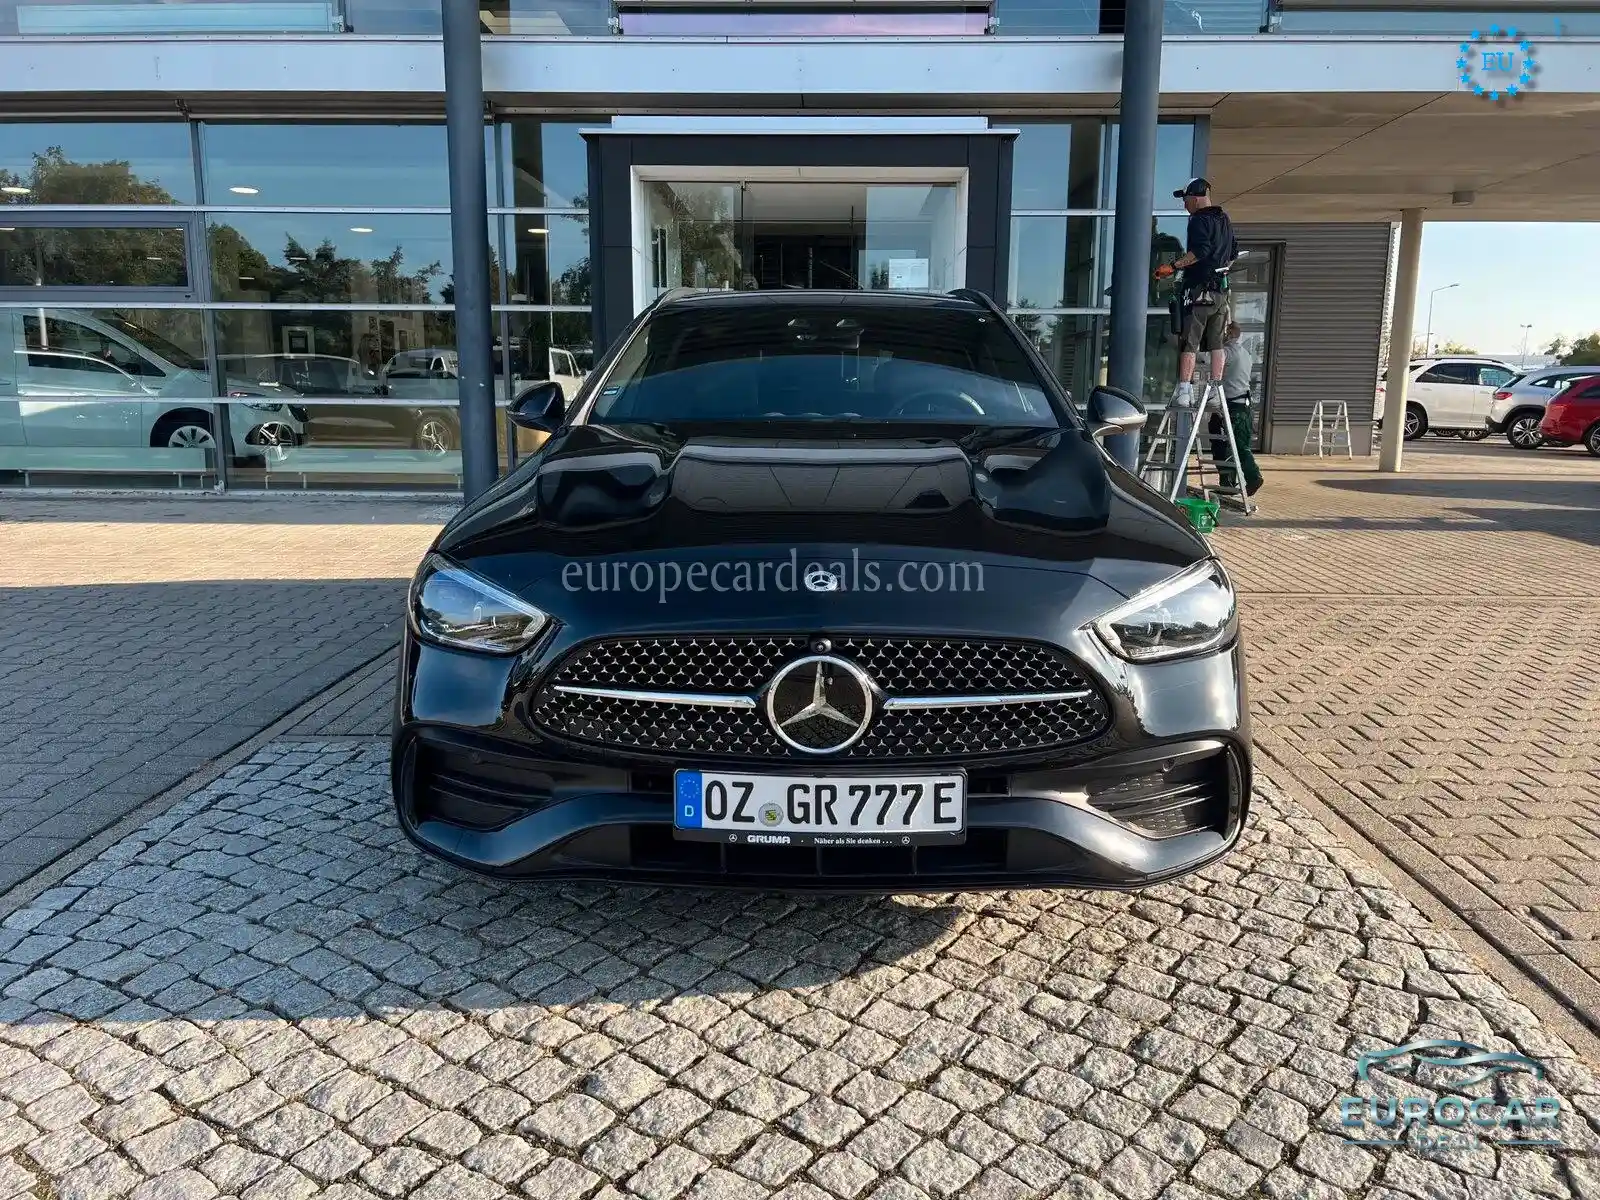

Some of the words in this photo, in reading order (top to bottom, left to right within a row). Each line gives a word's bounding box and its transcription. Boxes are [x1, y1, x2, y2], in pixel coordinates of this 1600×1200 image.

[705, 780, 756, 823] OZ
[786, 783, 838, 826] GR
[684, 804, 695, 817] D
[746, 834, 791, 844] GRUMA
[835, 837, 845, 845] als
[846, 837, 857, 845] Sie
[857, 837, 881, 845] denken
